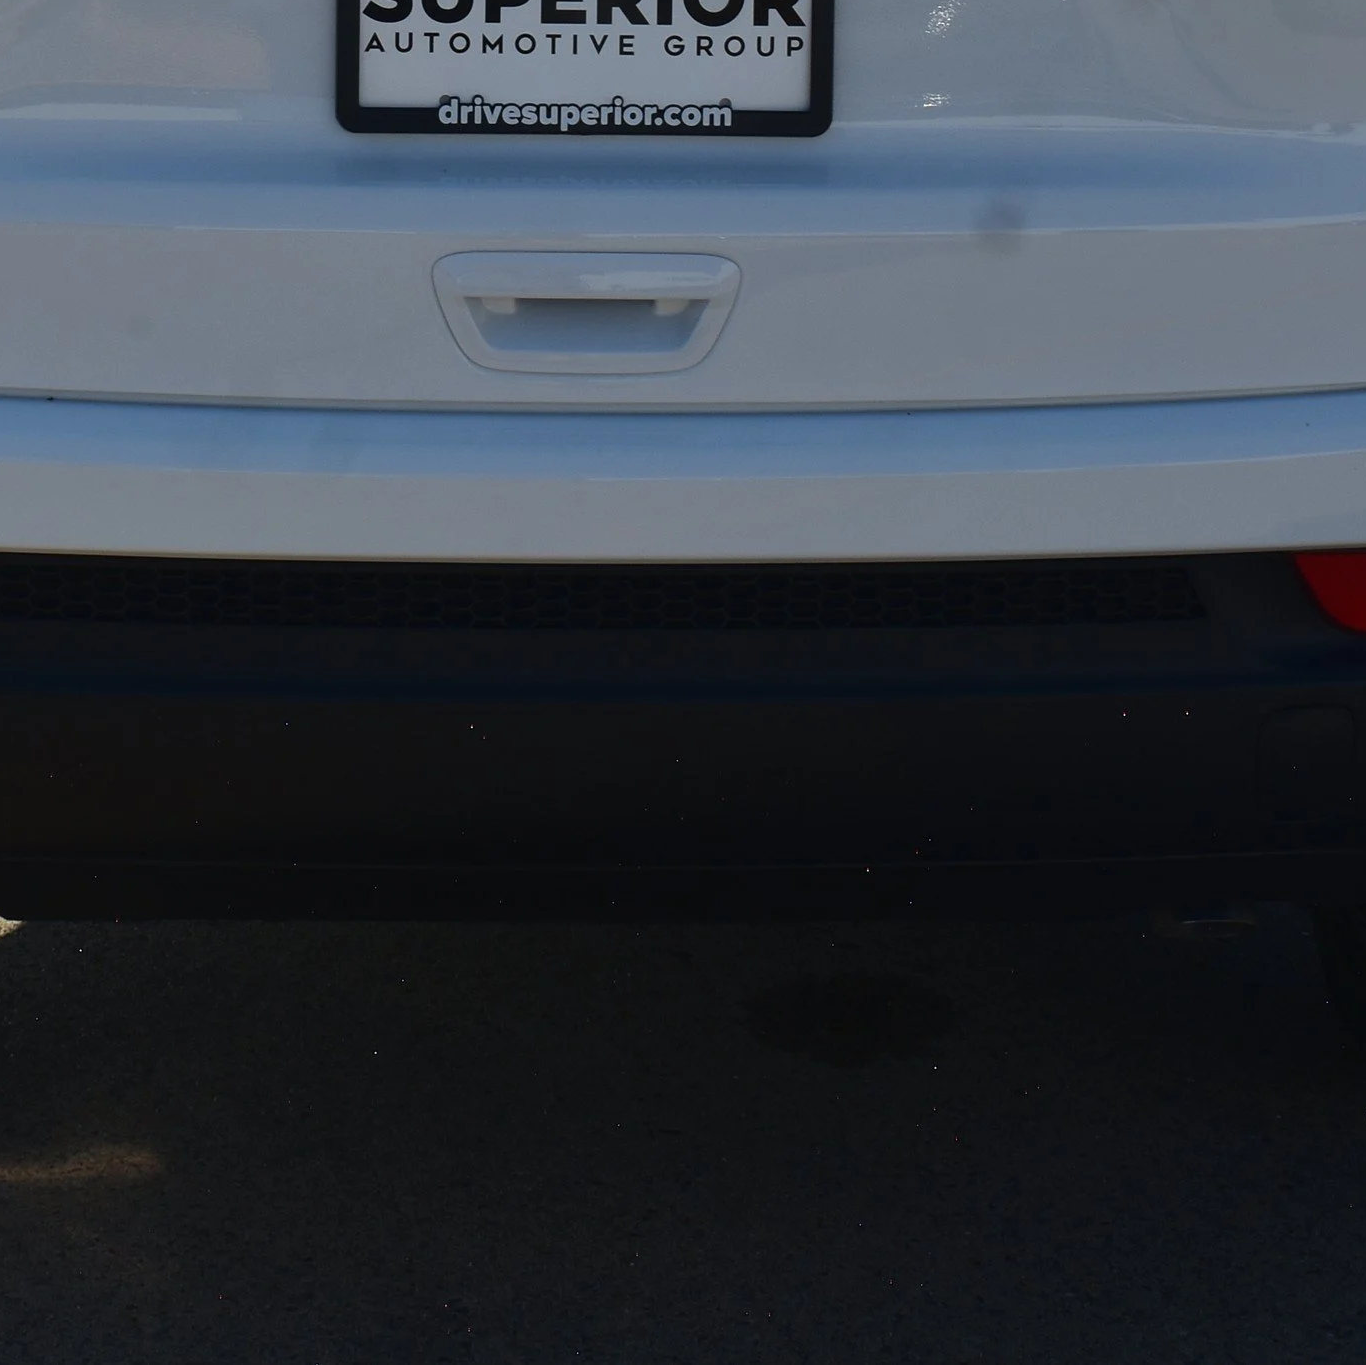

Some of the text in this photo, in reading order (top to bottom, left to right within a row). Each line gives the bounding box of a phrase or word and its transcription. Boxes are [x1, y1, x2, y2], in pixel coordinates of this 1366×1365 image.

[364, 31, 804, 58] AUTOMOTIVE GROUP
[438, 95, 733, 130] drivesuperior.com
